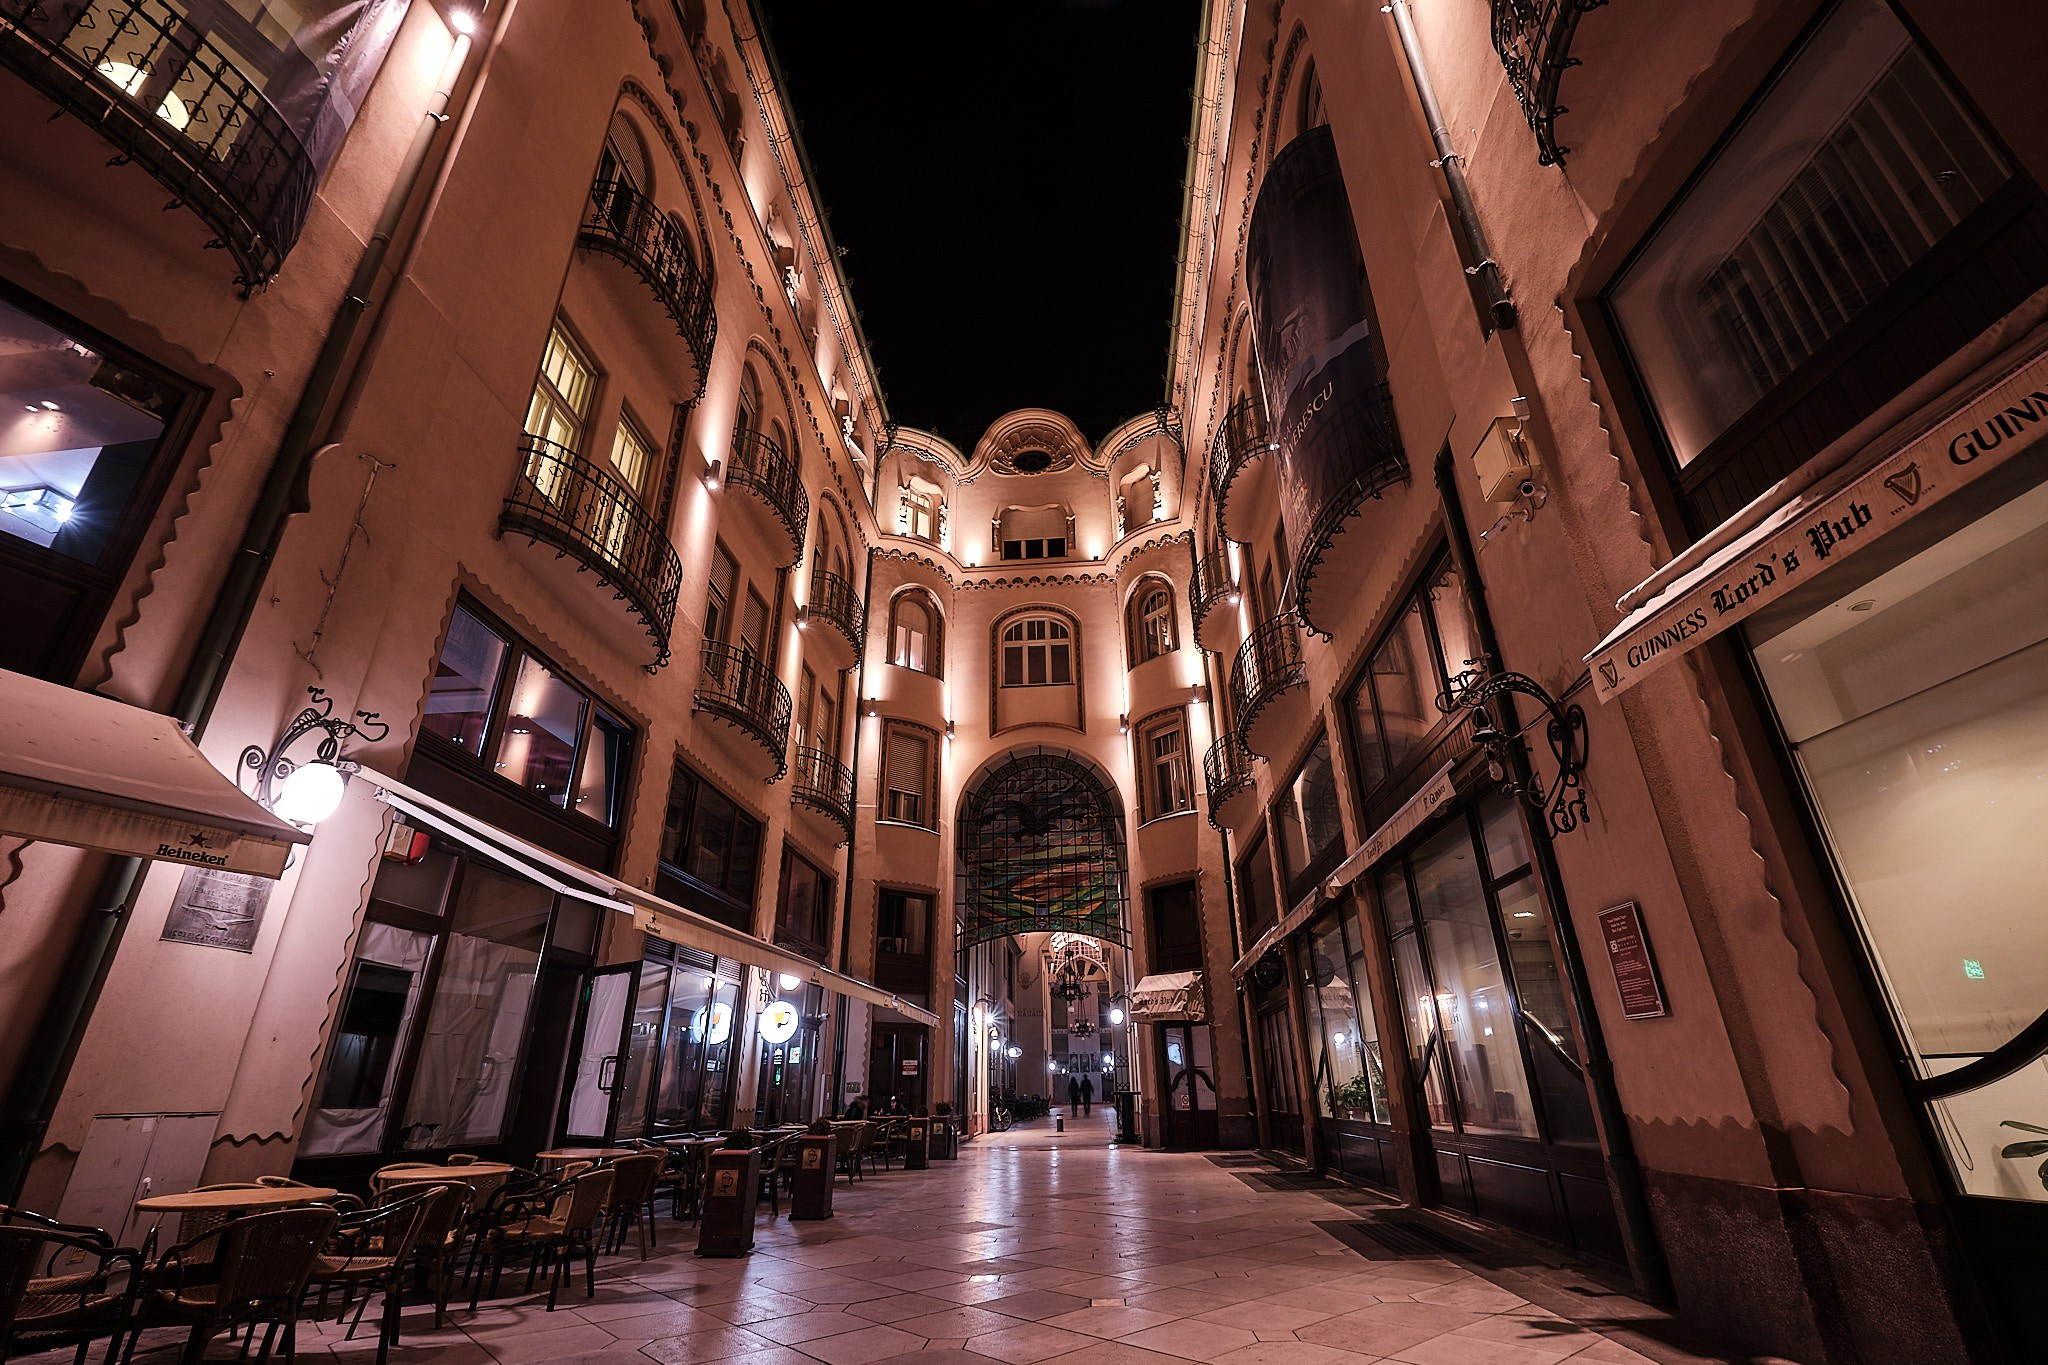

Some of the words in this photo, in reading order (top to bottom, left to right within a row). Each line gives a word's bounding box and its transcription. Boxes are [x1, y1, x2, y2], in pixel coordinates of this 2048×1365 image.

[1627, 607, 1708, 669] GUINNESS
[1711, 547, 1800, 617] Lord's
[1806, 500, 1873, 560] Pub
[156, 844, 229, 866] Heineken
